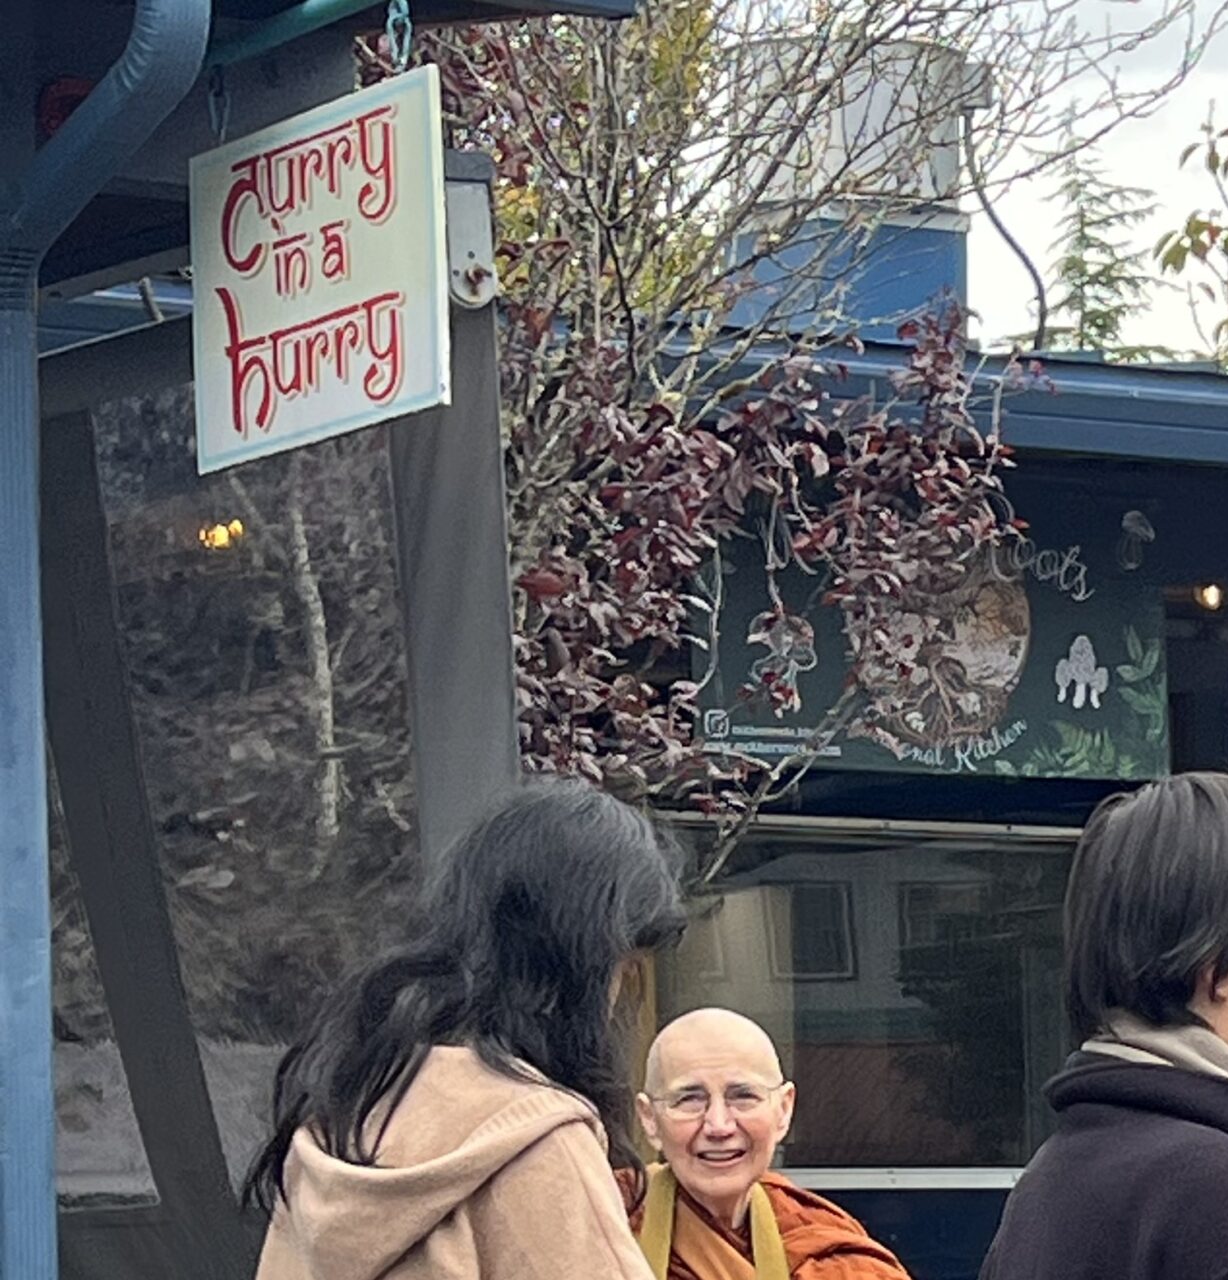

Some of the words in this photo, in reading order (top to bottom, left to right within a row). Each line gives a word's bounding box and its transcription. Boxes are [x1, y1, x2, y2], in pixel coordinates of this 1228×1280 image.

[221, 105, 397, 272] Curry
[271, 217, 308, 296] in
[321, 221, 348, 279] a
[214, 287, 402, 434] hurry
[950, 718, 1028, 773] Kitchen
